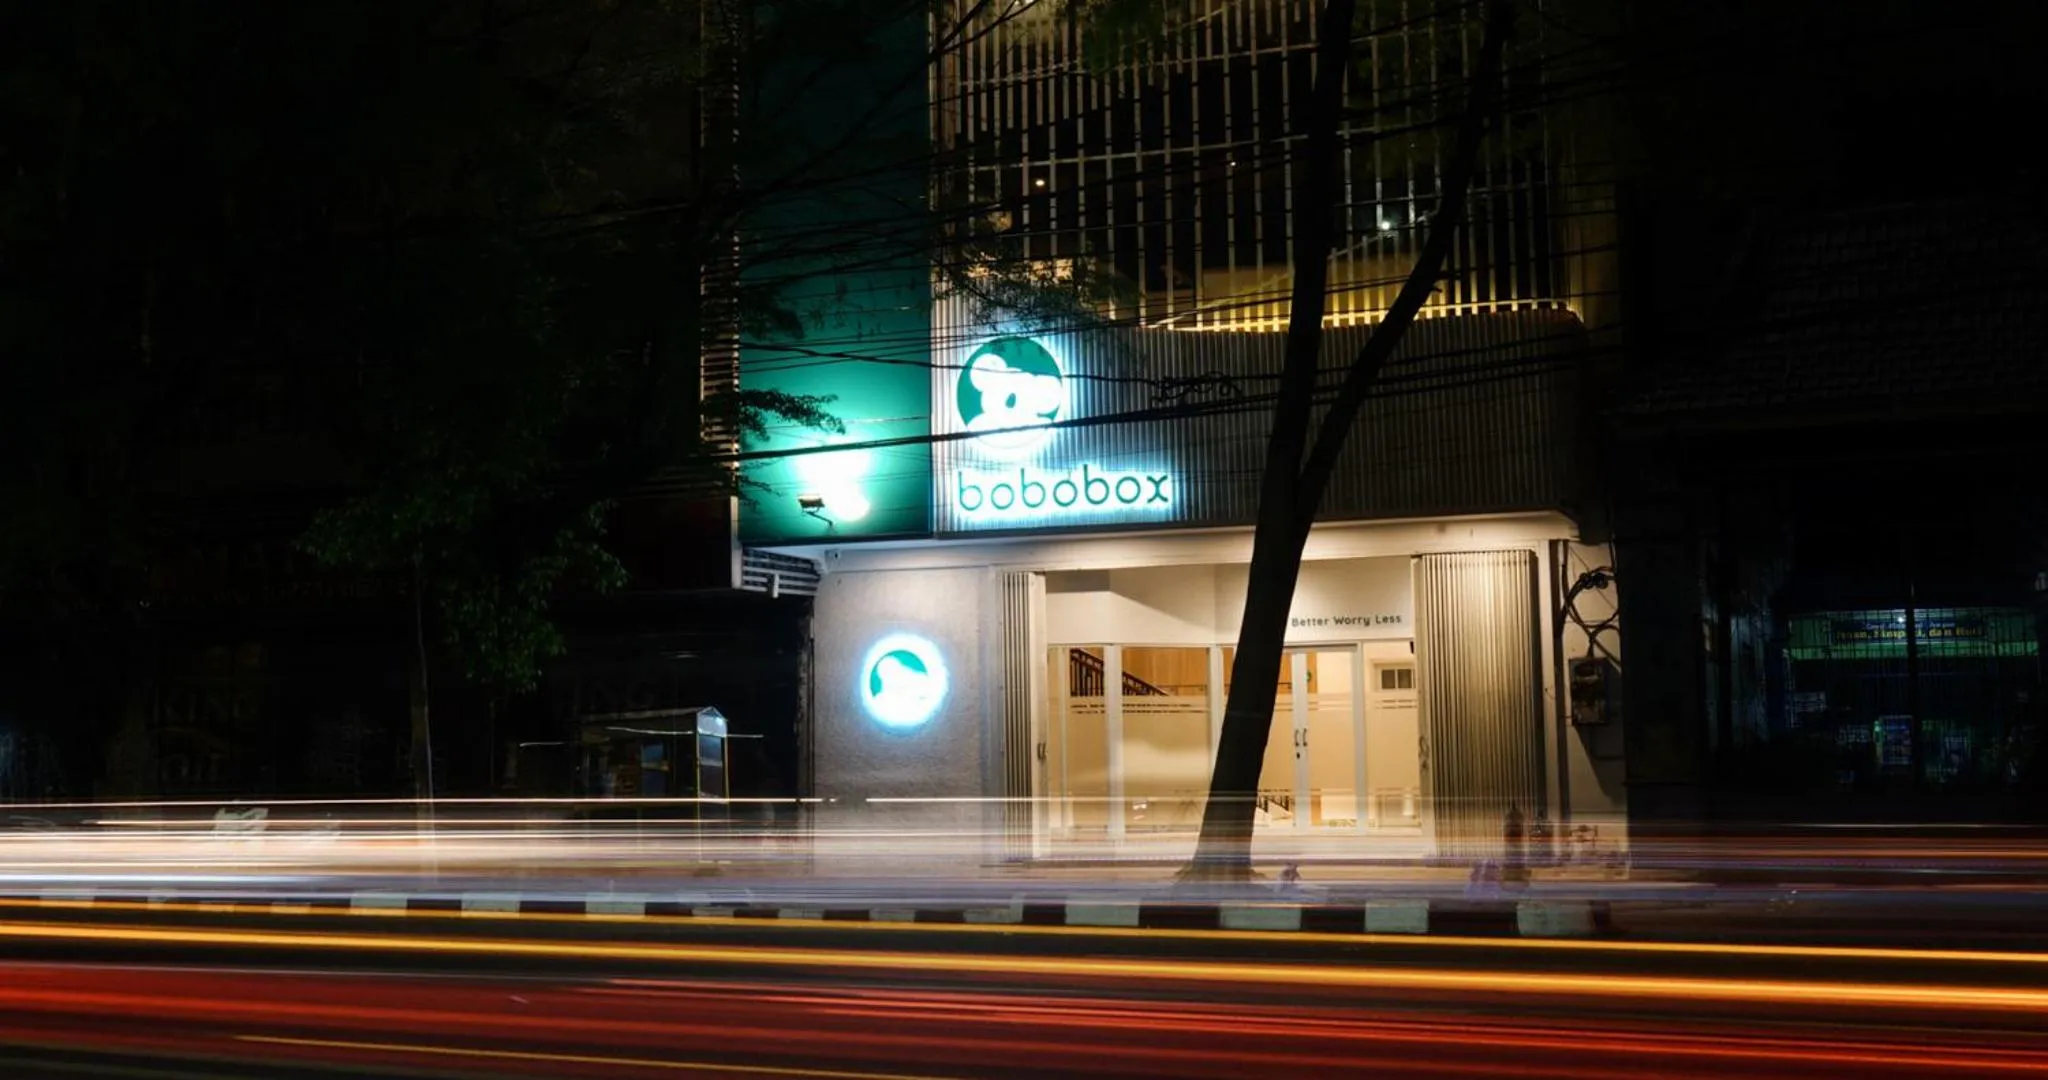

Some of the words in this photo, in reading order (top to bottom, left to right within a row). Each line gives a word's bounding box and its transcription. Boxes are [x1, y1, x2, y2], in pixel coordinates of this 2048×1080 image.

[958, 464, 1168, 511] bobobox
[1291, 617, 1328, 627] Better
[1333, 615, 1371, 627] Worry
[1375, 614, 1402, 625] Less
